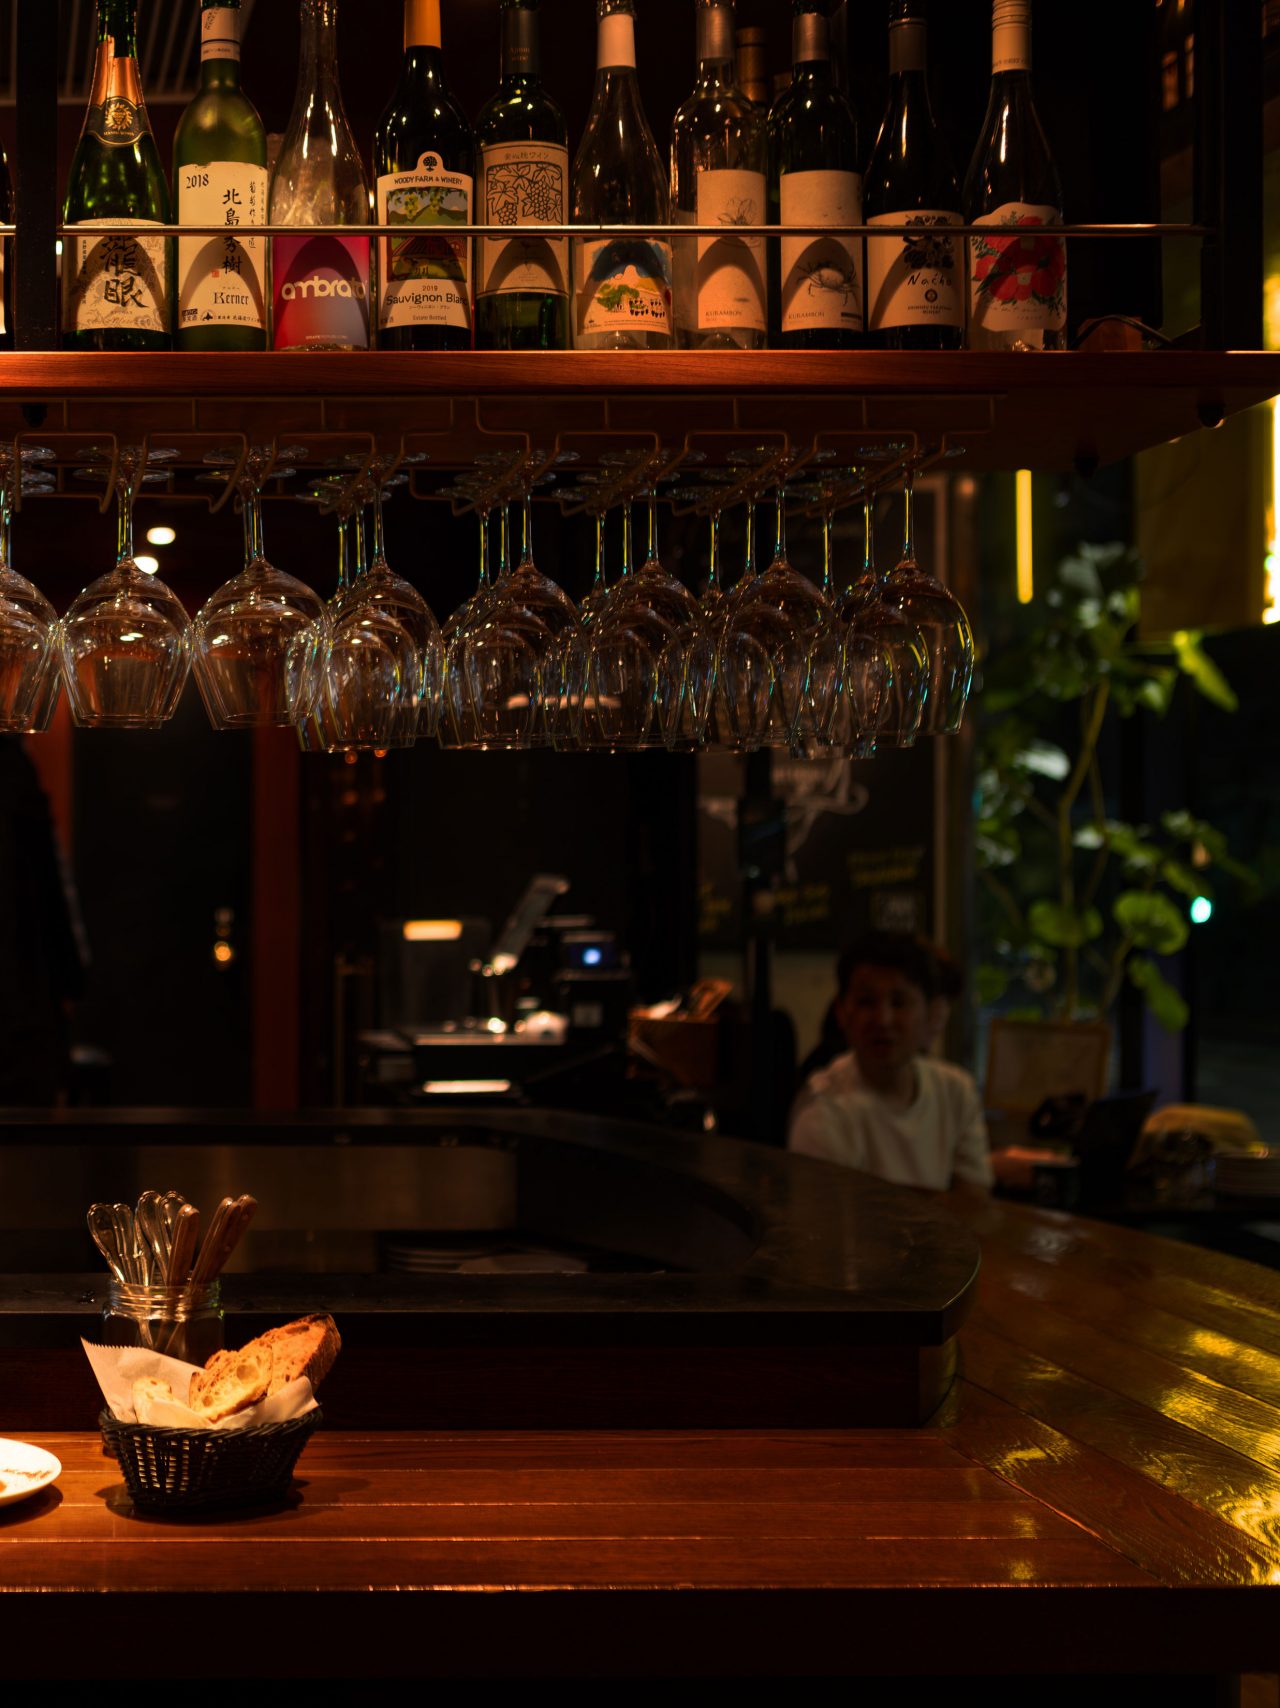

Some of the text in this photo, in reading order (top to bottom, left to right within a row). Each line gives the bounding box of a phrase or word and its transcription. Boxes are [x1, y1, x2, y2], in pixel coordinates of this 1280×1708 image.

[185, 173, 210, 189] 2018
[394, 175, 414, 184] WOODY
[440, 176, 463, 185] WINERY
[281, 275, 366, 300] ambrato
[214, 292, 249, 305] Kerner
[386, 292, 468, 306] Sauvignon Blanc
